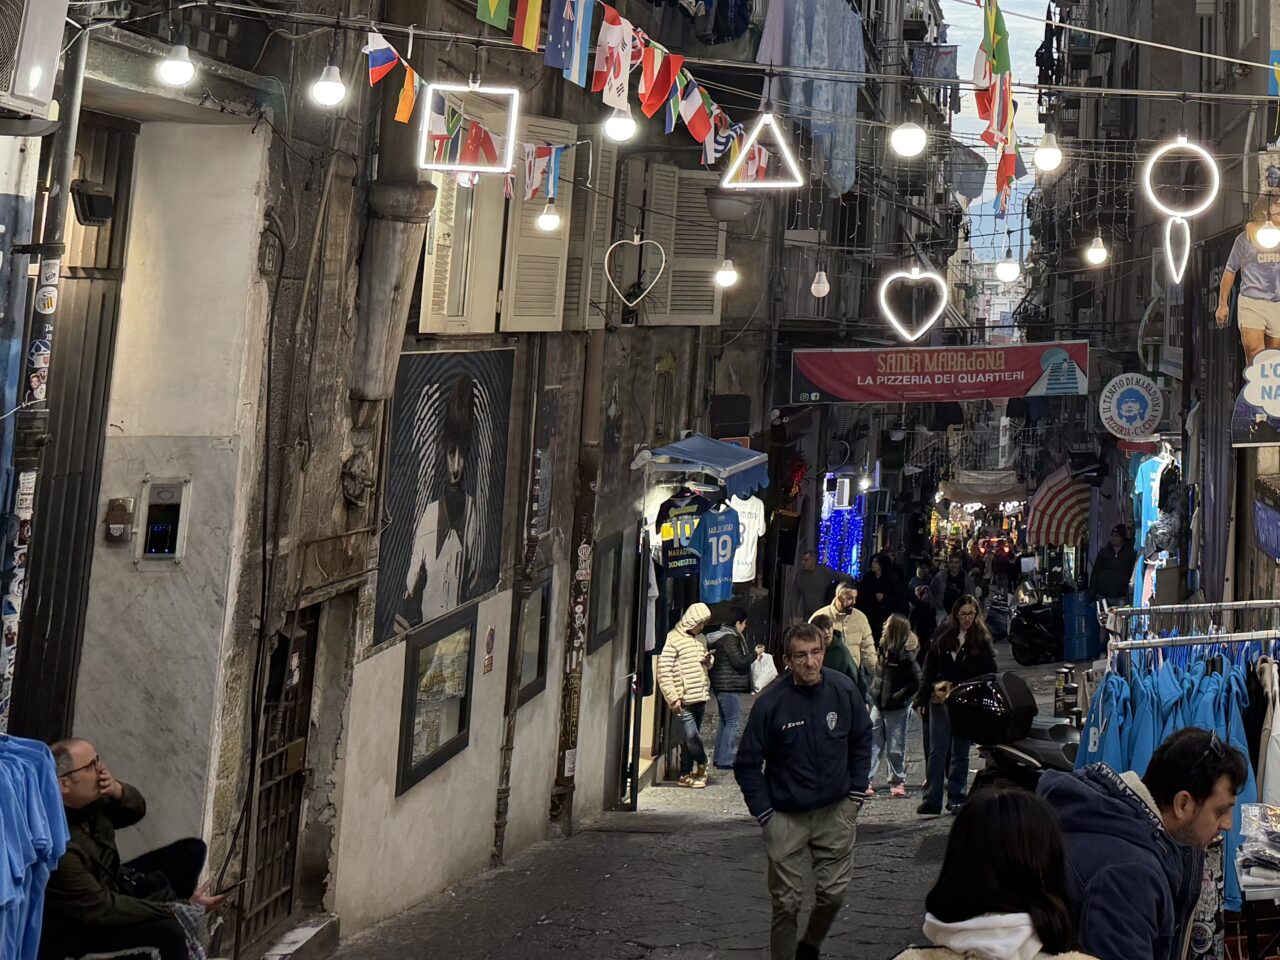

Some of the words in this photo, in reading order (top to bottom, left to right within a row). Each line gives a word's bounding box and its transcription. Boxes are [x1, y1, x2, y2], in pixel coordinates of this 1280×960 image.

[857, 376, 873, 385] LA
[877, 374, 932, 385] PIZZERIA
[935, 374, 955, 384] DEI
[959, 371, 1024, 384] QUARTIERI
[709, 535, 732, 565] 19
